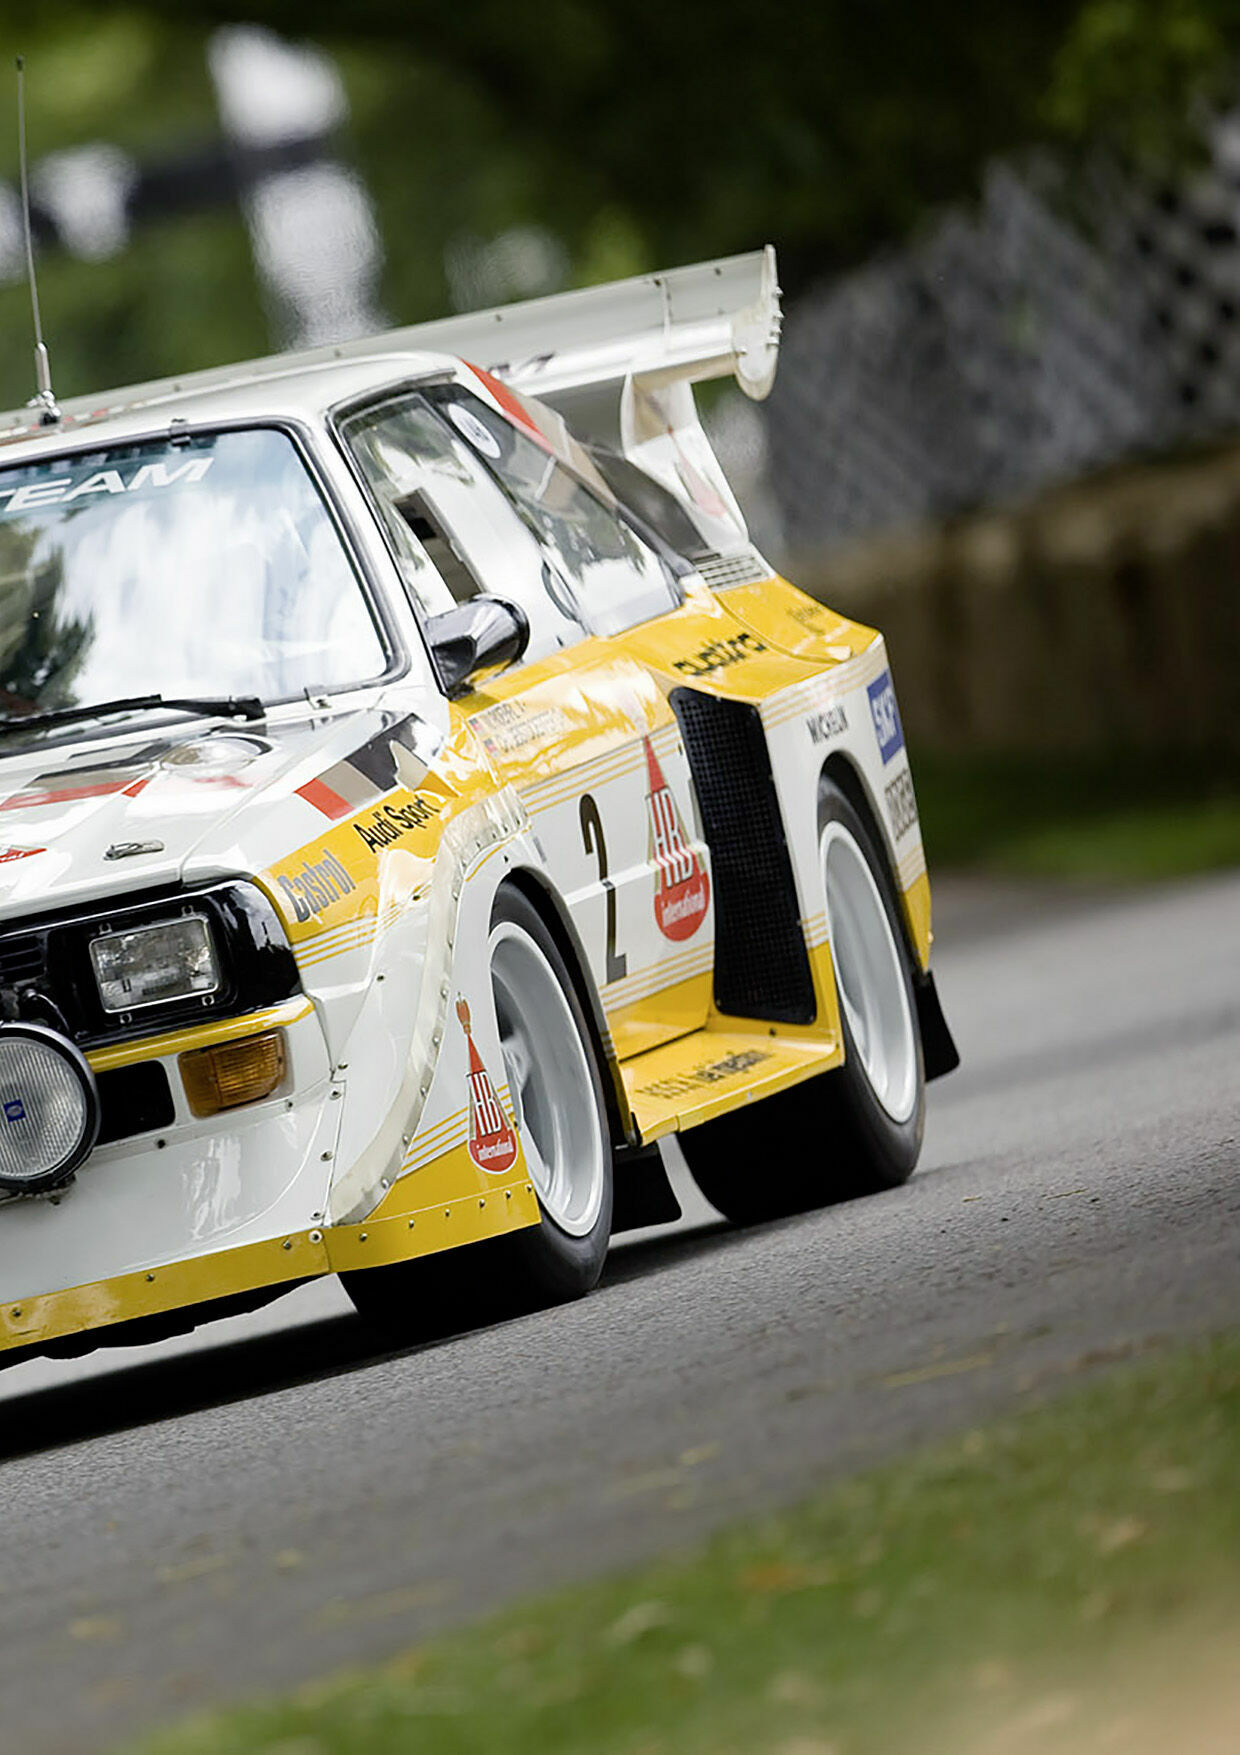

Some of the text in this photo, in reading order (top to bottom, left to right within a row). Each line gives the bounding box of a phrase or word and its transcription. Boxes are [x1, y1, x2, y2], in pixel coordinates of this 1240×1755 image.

[353, 795, 441, 853] Audi Sport
[646, 788, 694, 888] HB
[276, 848, 357, 923] Castrol
[579, 793, 627, 984] 2
[467, 1072, 502, 1137] HB
